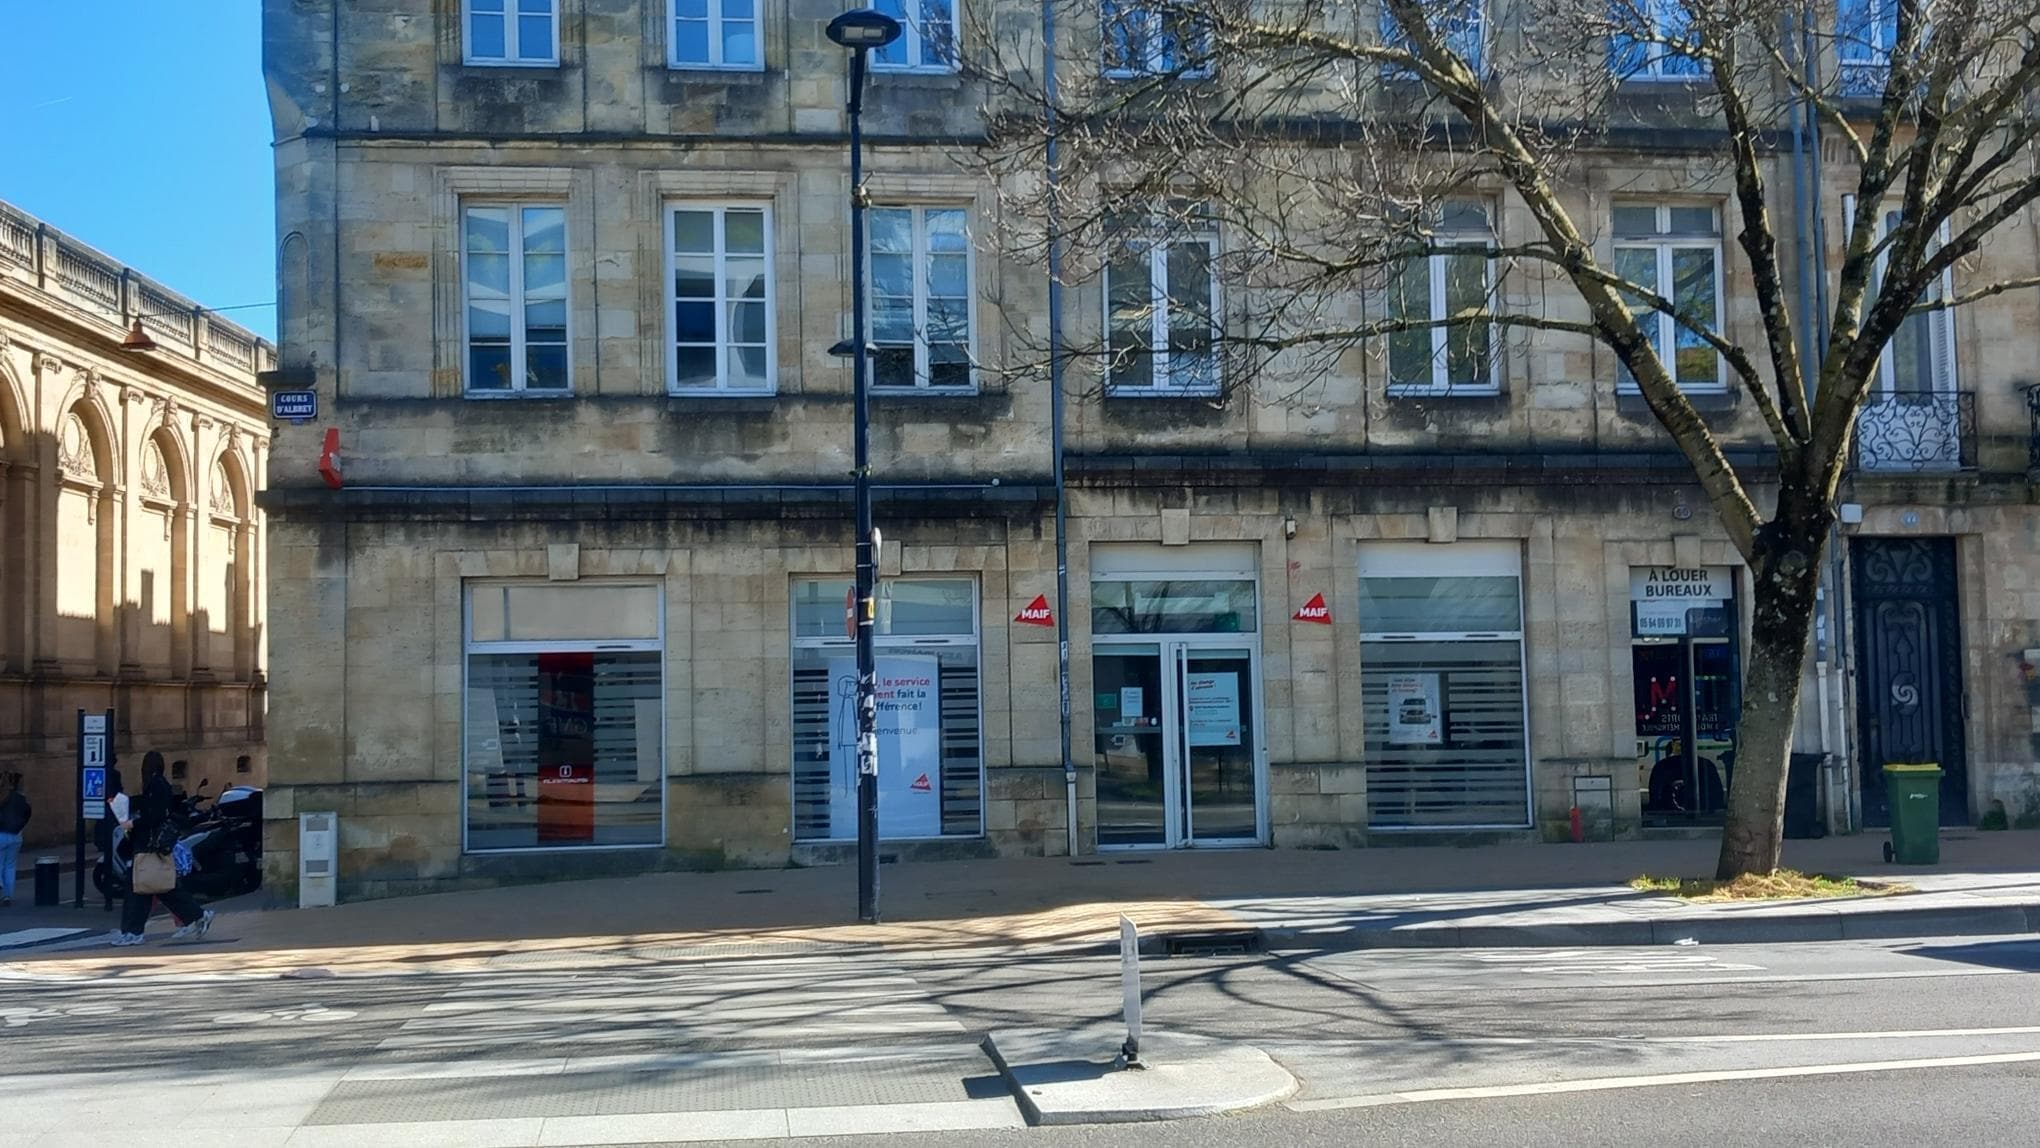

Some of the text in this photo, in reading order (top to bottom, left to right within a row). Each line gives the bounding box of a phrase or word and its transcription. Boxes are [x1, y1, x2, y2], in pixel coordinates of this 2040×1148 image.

[281, 394, 308, 402] COURS
[276, 405, 312, 414] D'ALBRET
[1662, 569, 1708, 582] LOUER
[1645, 584, 1712, 597] BUREAUX
[1021, 608, 1050, 619] MAIF
[1299, 607, 1328, 617] MAIF
[882, 677, 930, 687] le service
[874, 689, 926, 699] ent fait la
[876, 701, 922, 712] fférence!
[876, 727, 921, 736] envenue.
